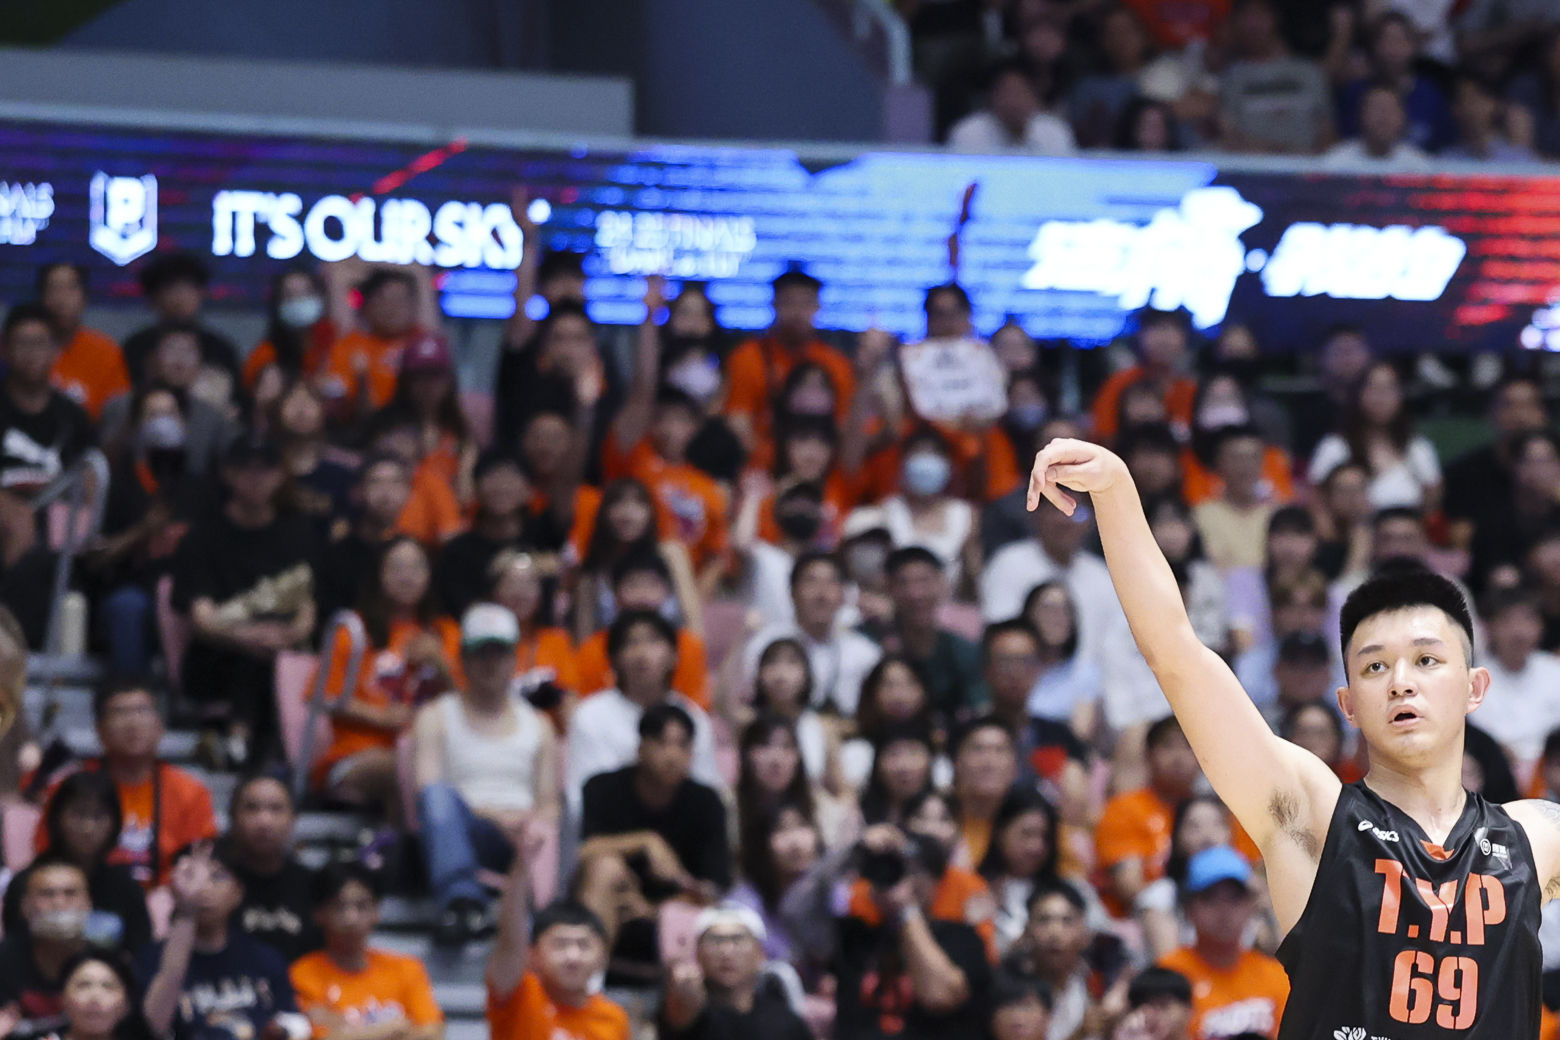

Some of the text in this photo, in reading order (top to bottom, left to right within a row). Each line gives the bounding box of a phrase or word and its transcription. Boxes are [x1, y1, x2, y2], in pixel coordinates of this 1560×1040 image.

[304, 195, 434, 266] OUR
[1374, 858, 1507, 946] T.Y.P
[1388, 949, 1480, 1031] 69
